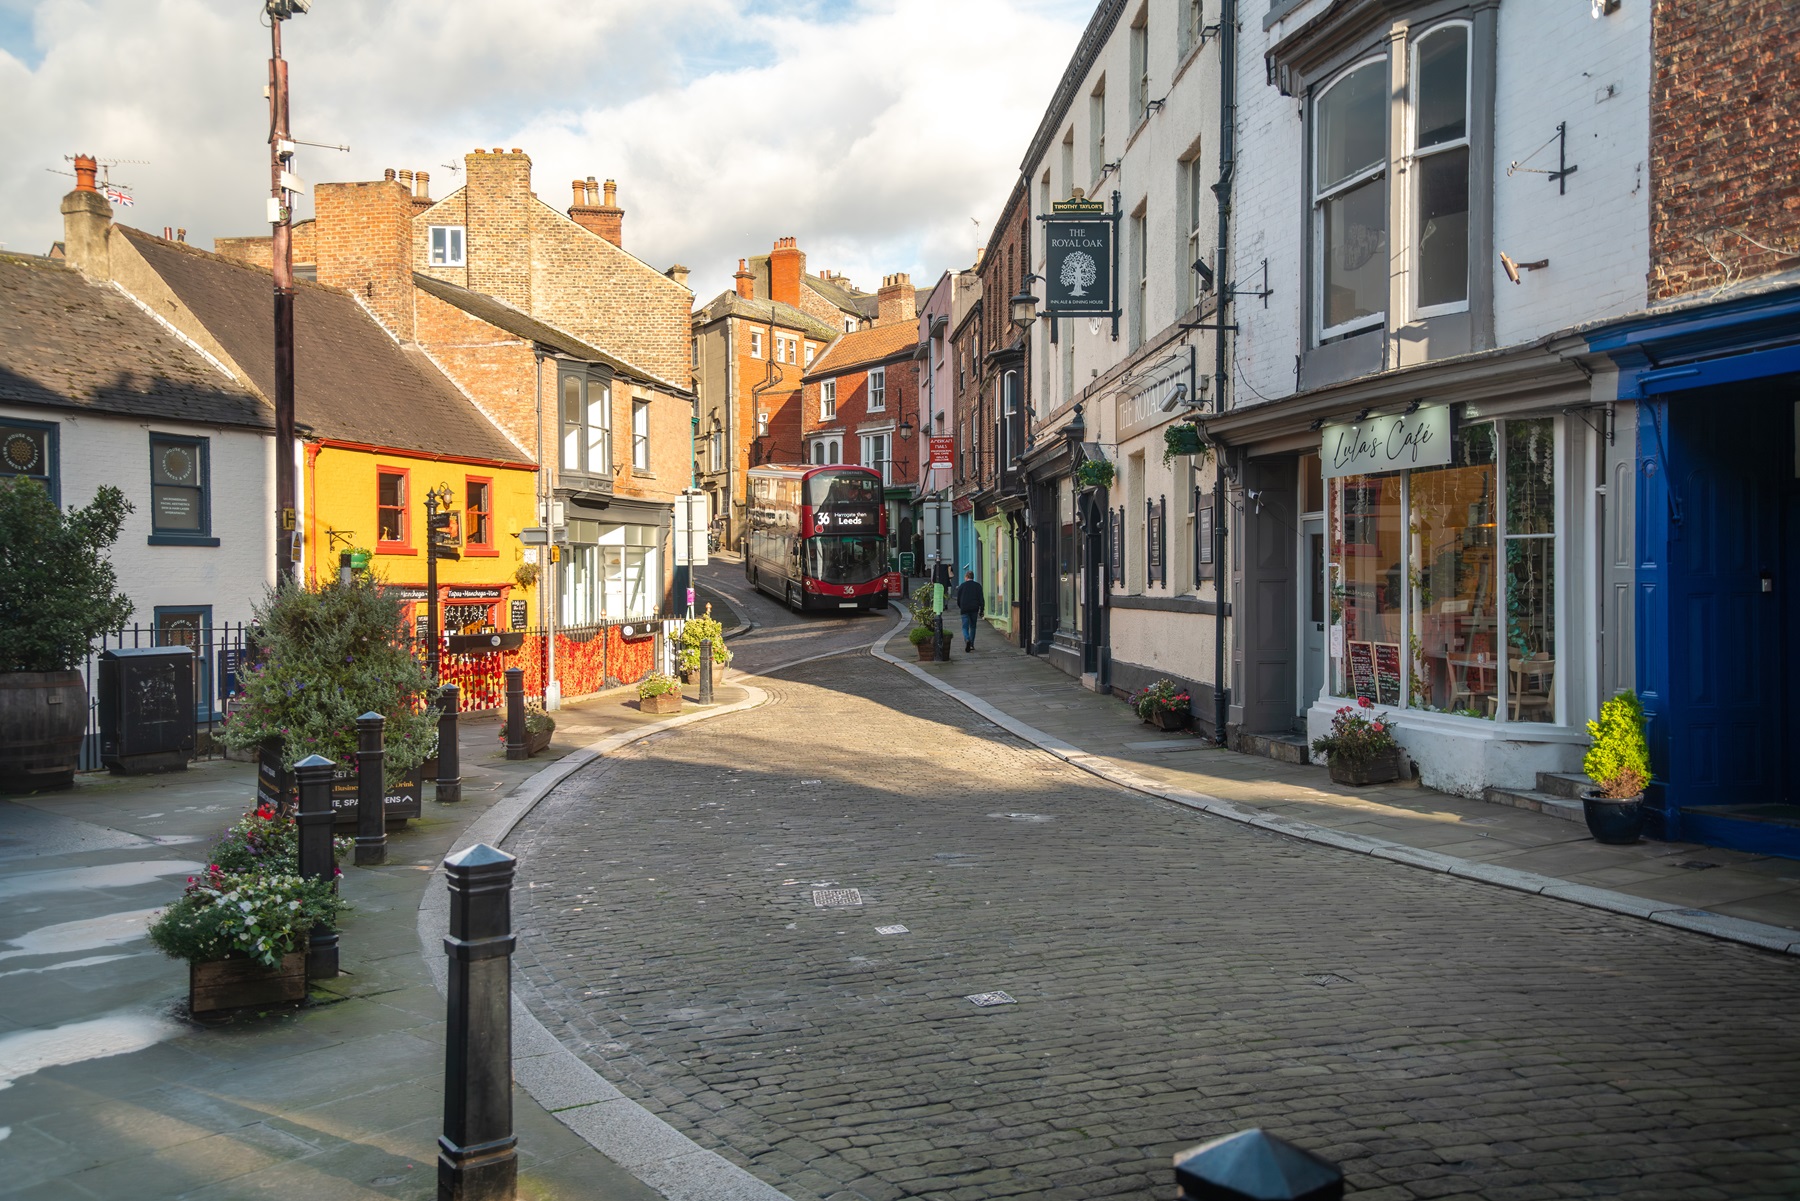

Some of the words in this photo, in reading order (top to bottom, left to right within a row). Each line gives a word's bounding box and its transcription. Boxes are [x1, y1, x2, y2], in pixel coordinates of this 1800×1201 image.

[1069, 228, 1086, 237] THE
[1051, 239, 1081, 248] ROYAL
[1082, 239, 1104, 248] OAK
[1119, 398, 1133, 431] THE
[1134, 381, 1162, 423] ROYAL
[8, 433, 26, 441] HOUSE
[1333, 425, 1383, 470] Lula's
[1386, 419, 1434, 463] Café
[817, 512, 830, 525] 36
[838, 516, 863, 525] Leeds
[843, 585, 855, 595] 36
